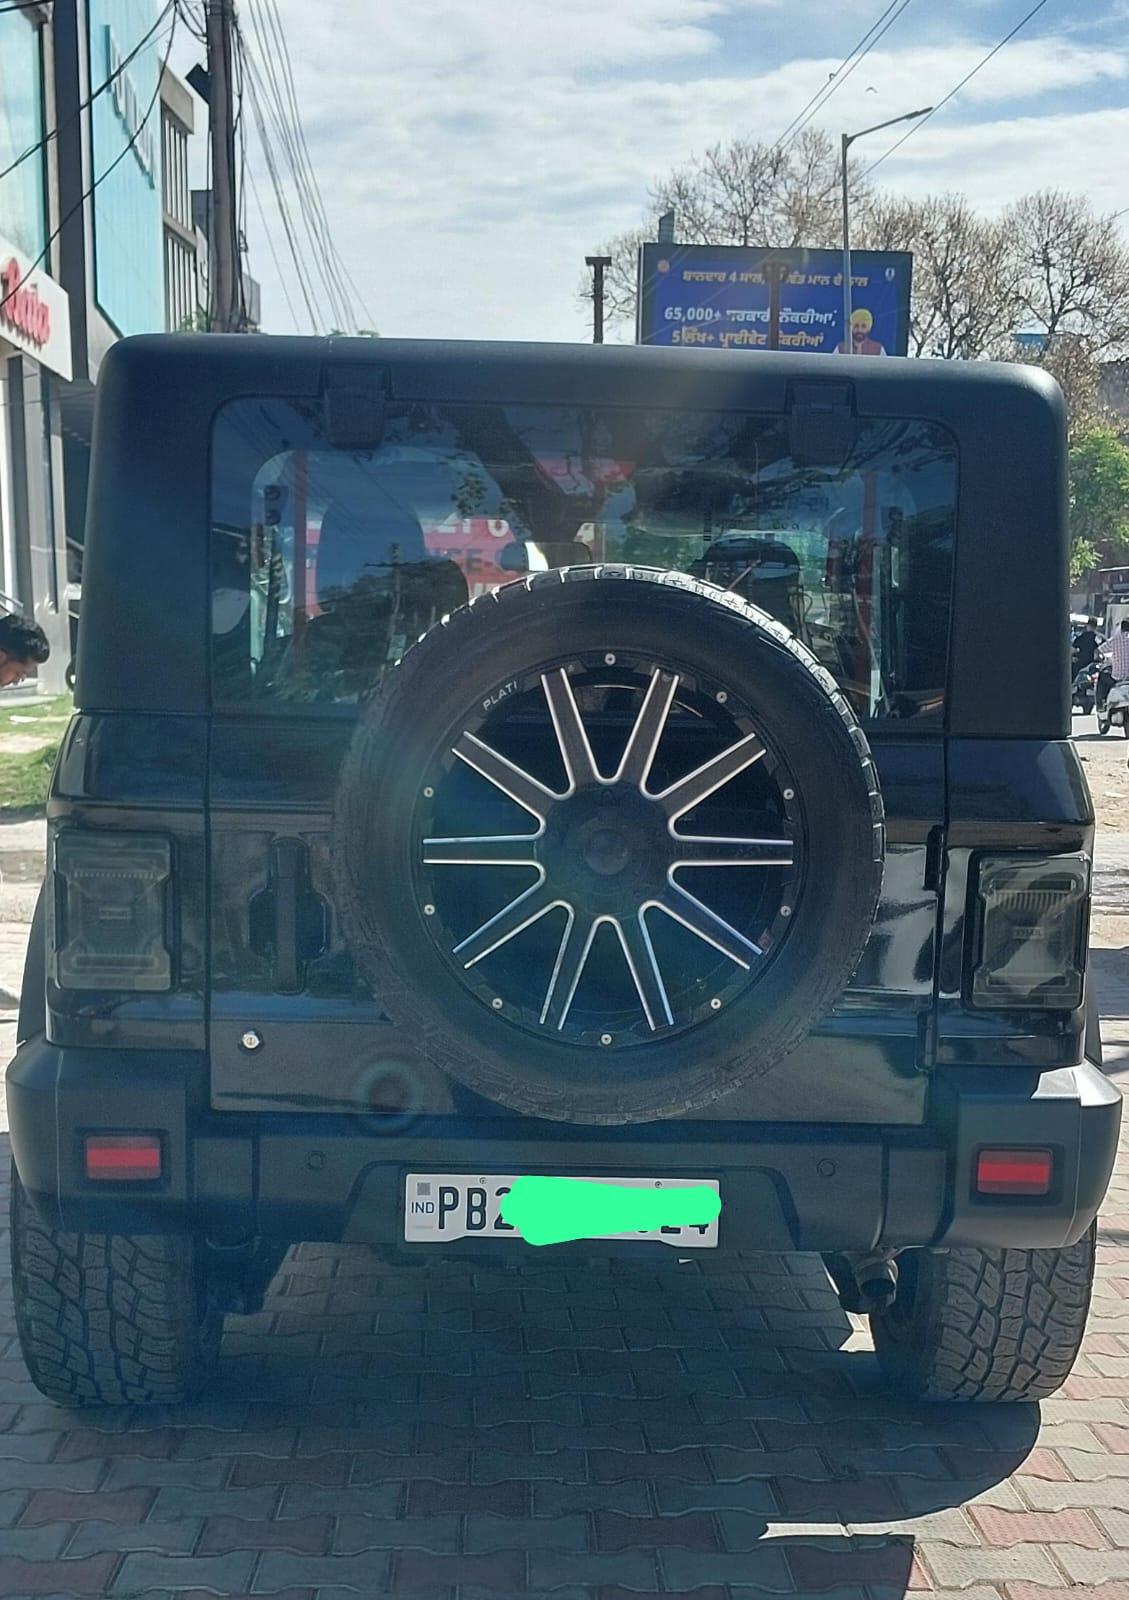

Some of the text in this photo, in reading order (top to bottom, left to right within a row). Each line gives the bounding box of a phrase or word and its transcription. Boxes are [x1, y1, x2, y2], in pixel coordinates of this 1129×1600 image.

[729, 270, 737, 284] 4
[664, 306, 722, 323] 65,000+
[671, 330, 681, 343] 5
[411, 1202, 435, 1214] IND
